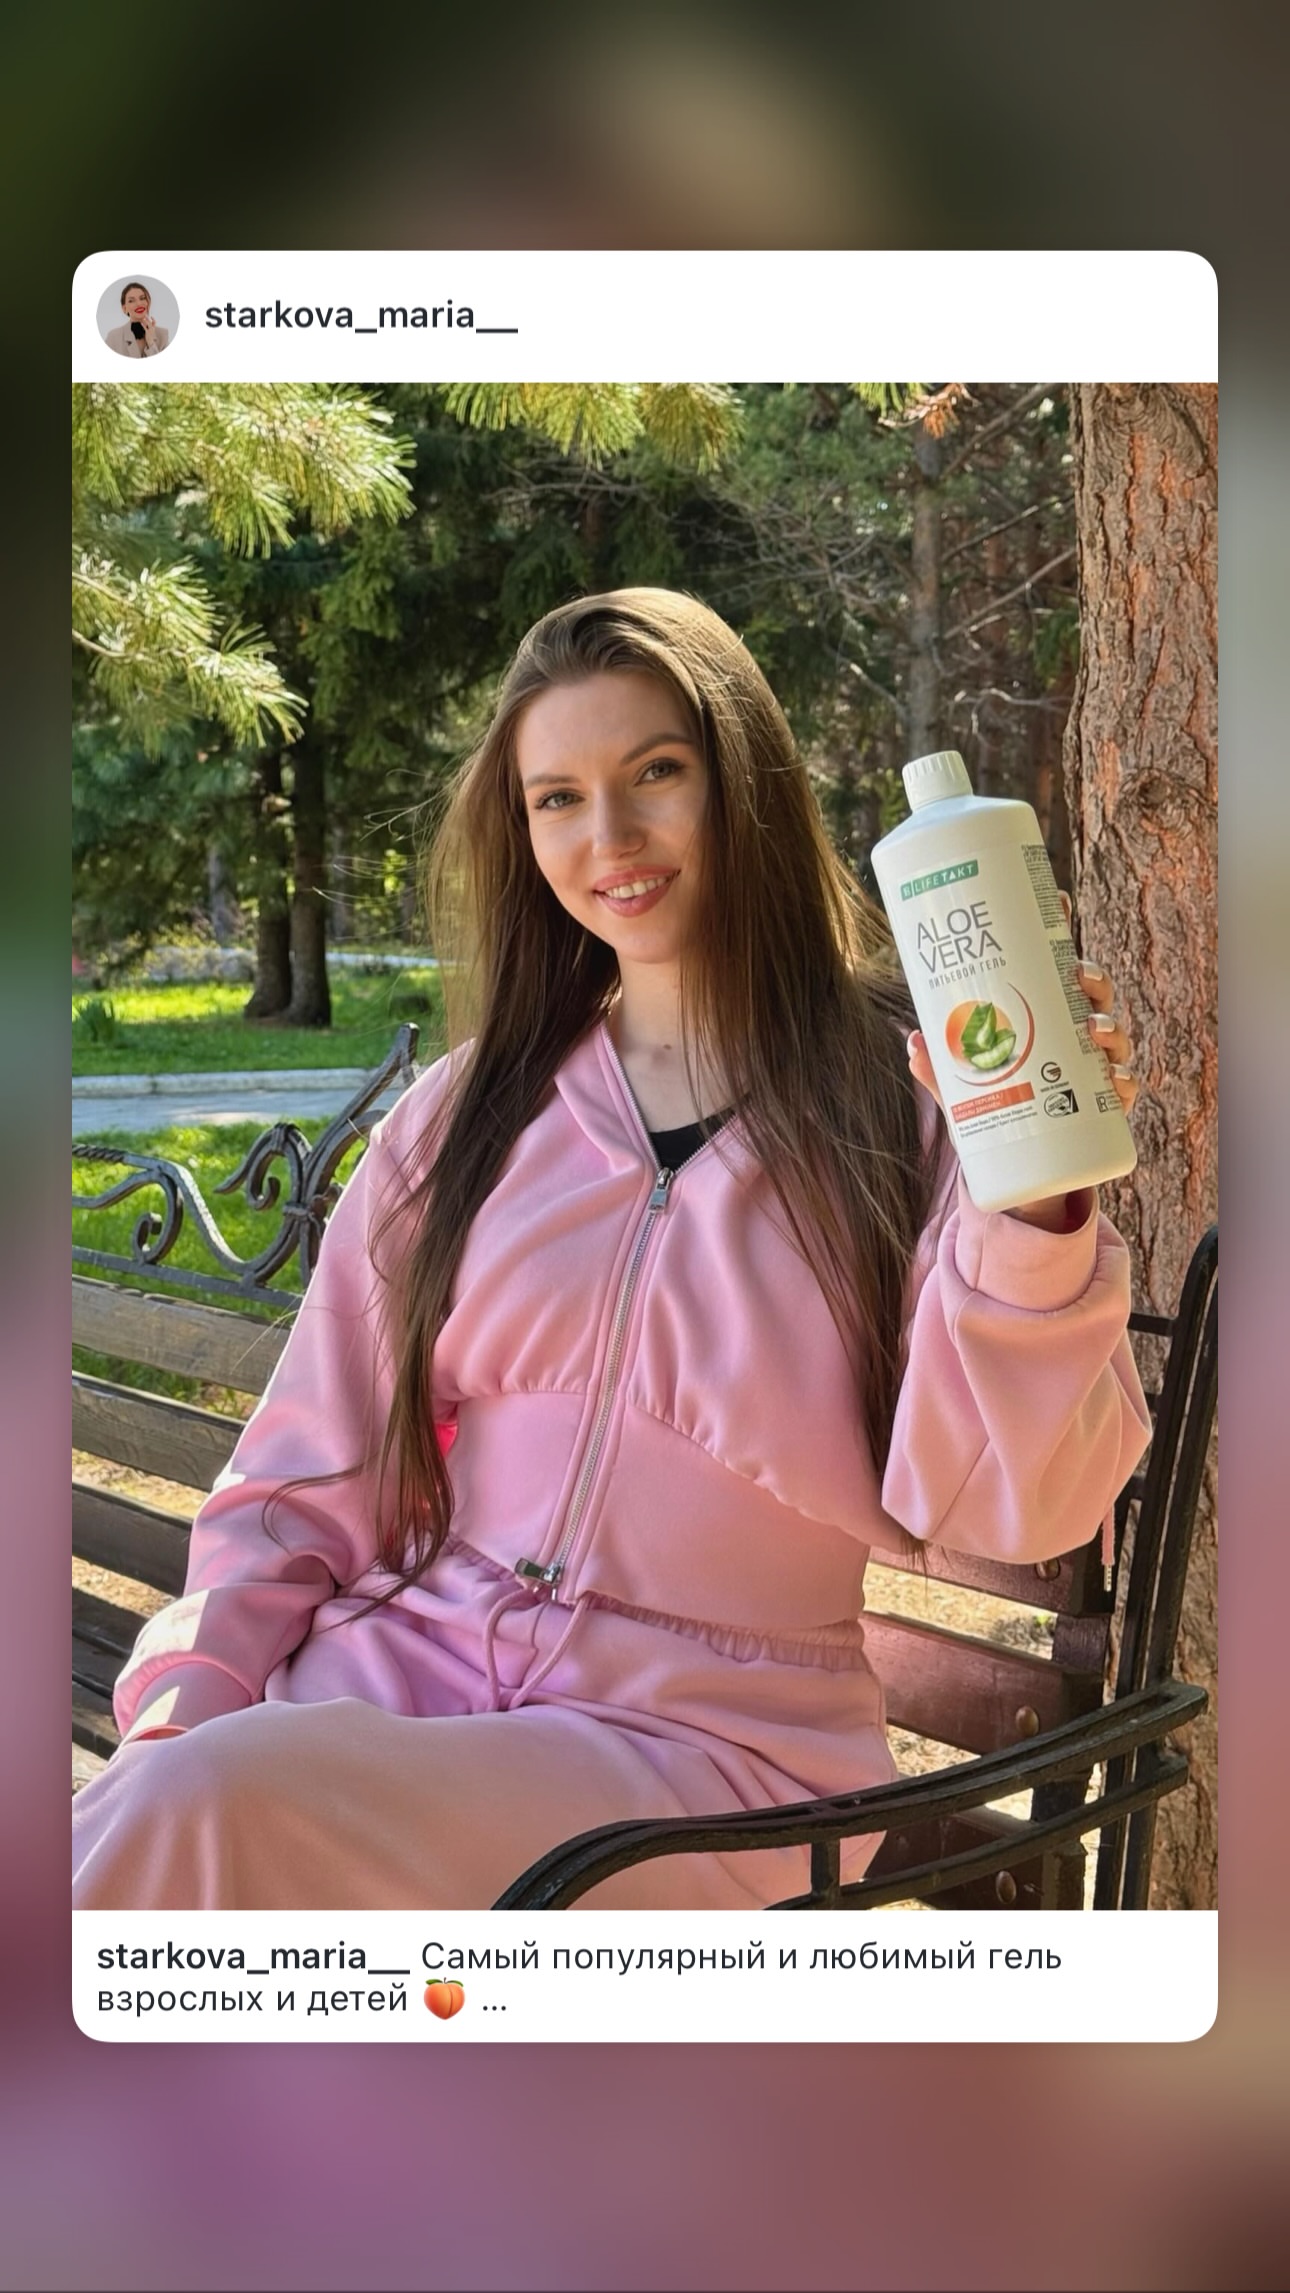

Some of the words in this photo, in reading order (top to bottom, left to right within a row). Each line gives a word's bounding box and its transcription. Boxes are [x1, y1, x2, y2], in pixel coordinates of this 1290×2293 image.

[914, 864, 974, 893] LIFETAKT
[917, 901, 993, 950] ALOE
[919, 929, 1003, 974] VERA
[928, 963, 976, 989] ПИТЬЕВОЙ
[979, 956, 1007, 972] ГЕЛЬ
